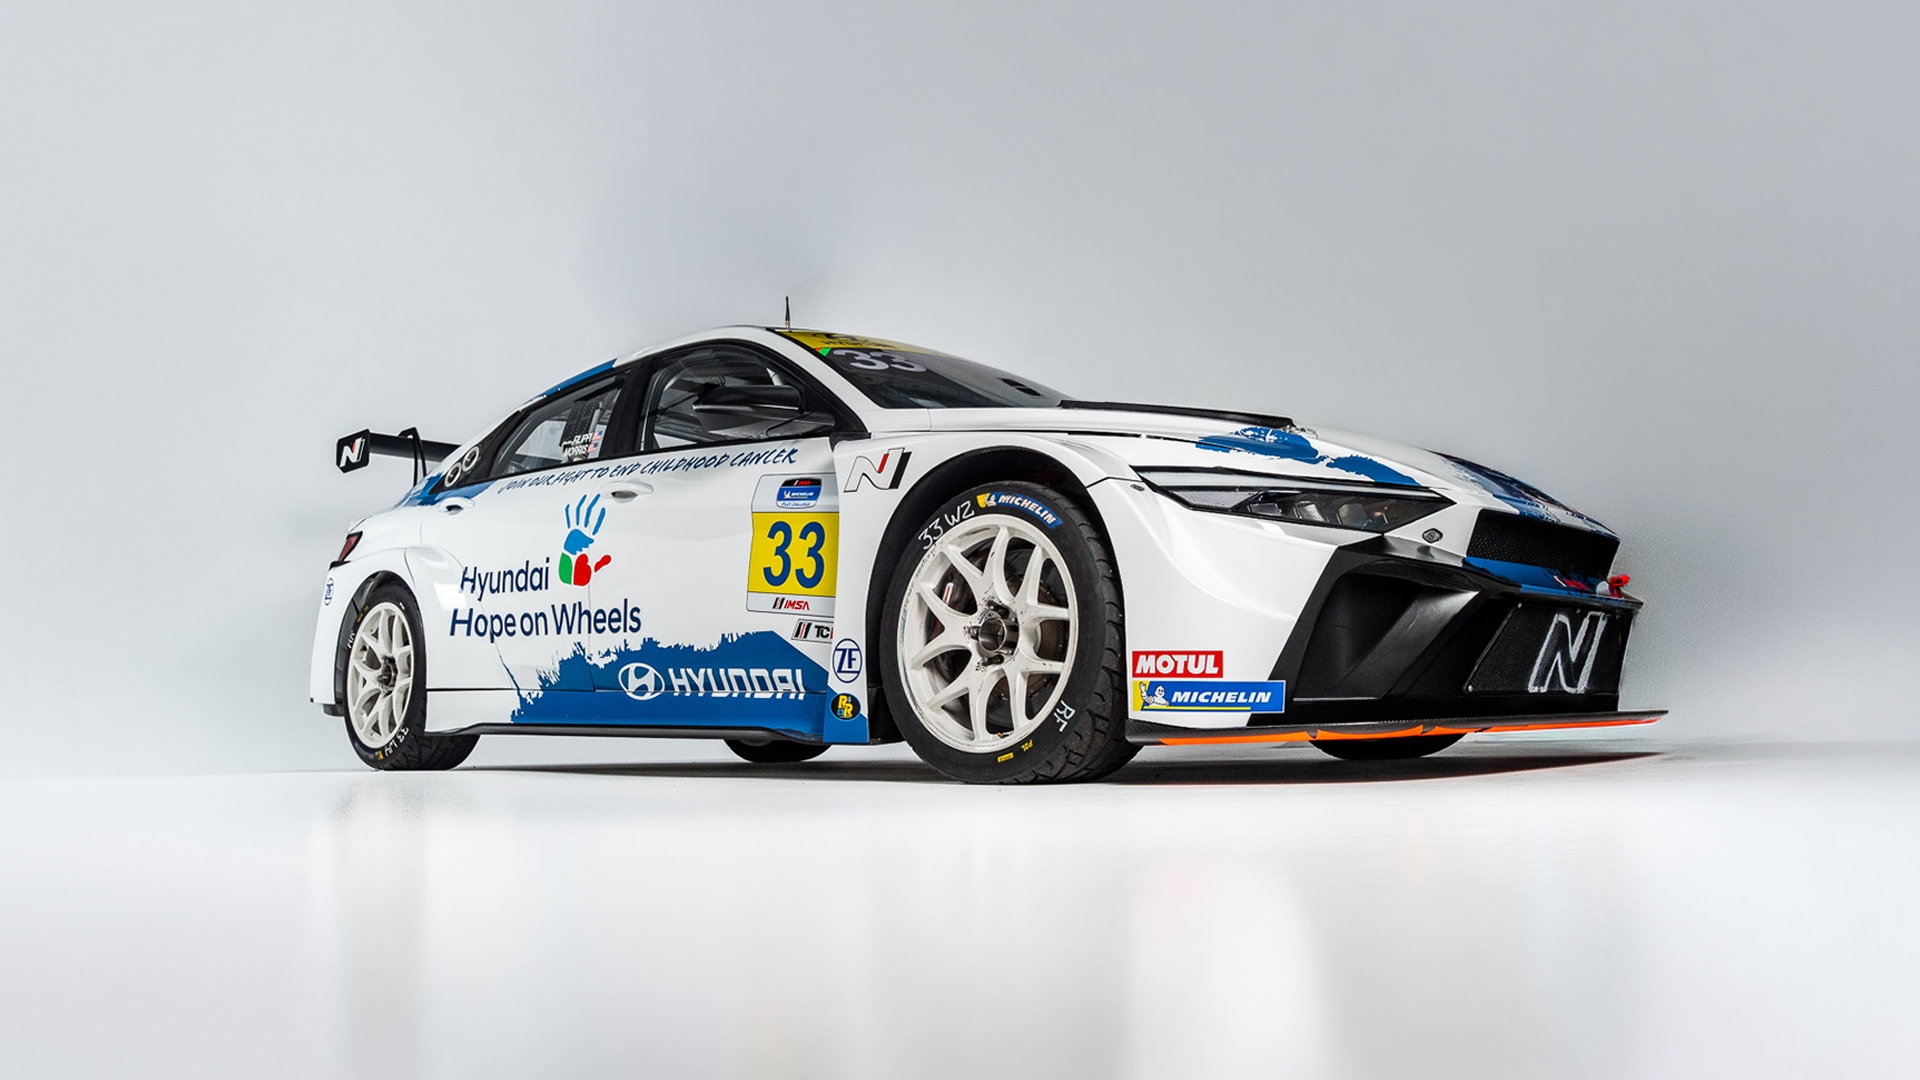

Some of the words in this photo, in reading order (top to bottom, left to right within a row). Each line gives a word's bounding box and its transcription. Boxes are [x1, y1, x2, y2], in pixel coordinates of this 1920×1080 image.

[833, 349, 927, 373] 33
[498, 478, 527, 494] JOIN
[528, 474, 554, 487] OUR
[551, 468, 593, 486] FIGHT
[591, 467, 609, 480] TO
[609, 462, 641, 477] END
[640, 452, 730, 475] CHILDHOOD
[730, 448, 798, 467] CANCER
[998, 495, 1057, 524] MICHELIN
[917, 517, 944, 550] 33
[763, 520, 825, 589] 33
[459, 556, 550, 602] Hyundai
[784, 600, 810, 611] IMSA
[450, 607, 516, 644] Hope
[520, 610, 548, 636] on
[551, 598, 642, 636] Wheels
[814, 625, 833, 639] TC
[835, 648, 860, 674] ZF
[1135, 654, 1219, 674] MOTUL
[668, 668, 806, 701] HYUNDAI
[1171, 690, 1272, 704] MICHELIN
[1053, 700, 1076, 732] RF
